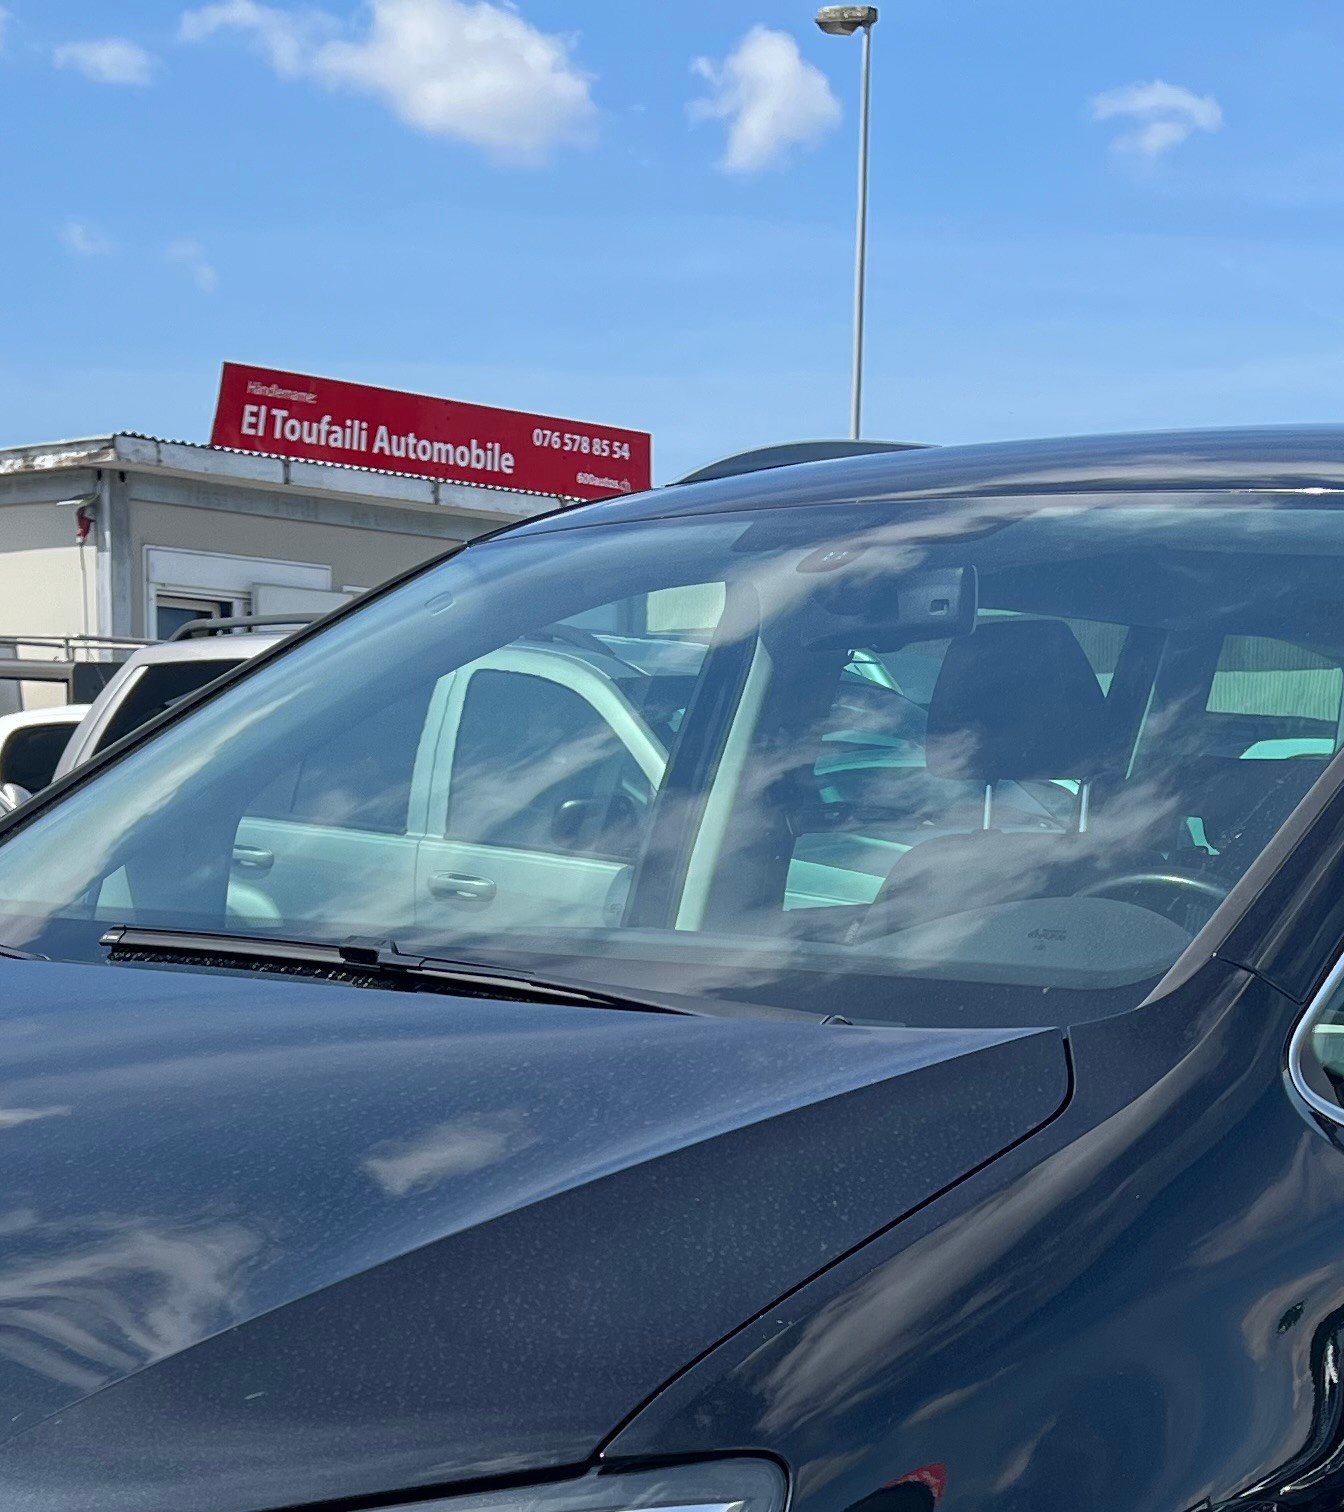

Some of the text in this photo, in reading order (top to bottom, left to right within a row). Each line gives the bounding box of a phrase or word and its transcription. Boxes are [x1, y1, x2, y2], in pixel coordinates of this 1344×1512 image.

[240, 403, 515, 474] El Toufaili Automobile
[532, 428, 631, 460] 076 578 85 54
